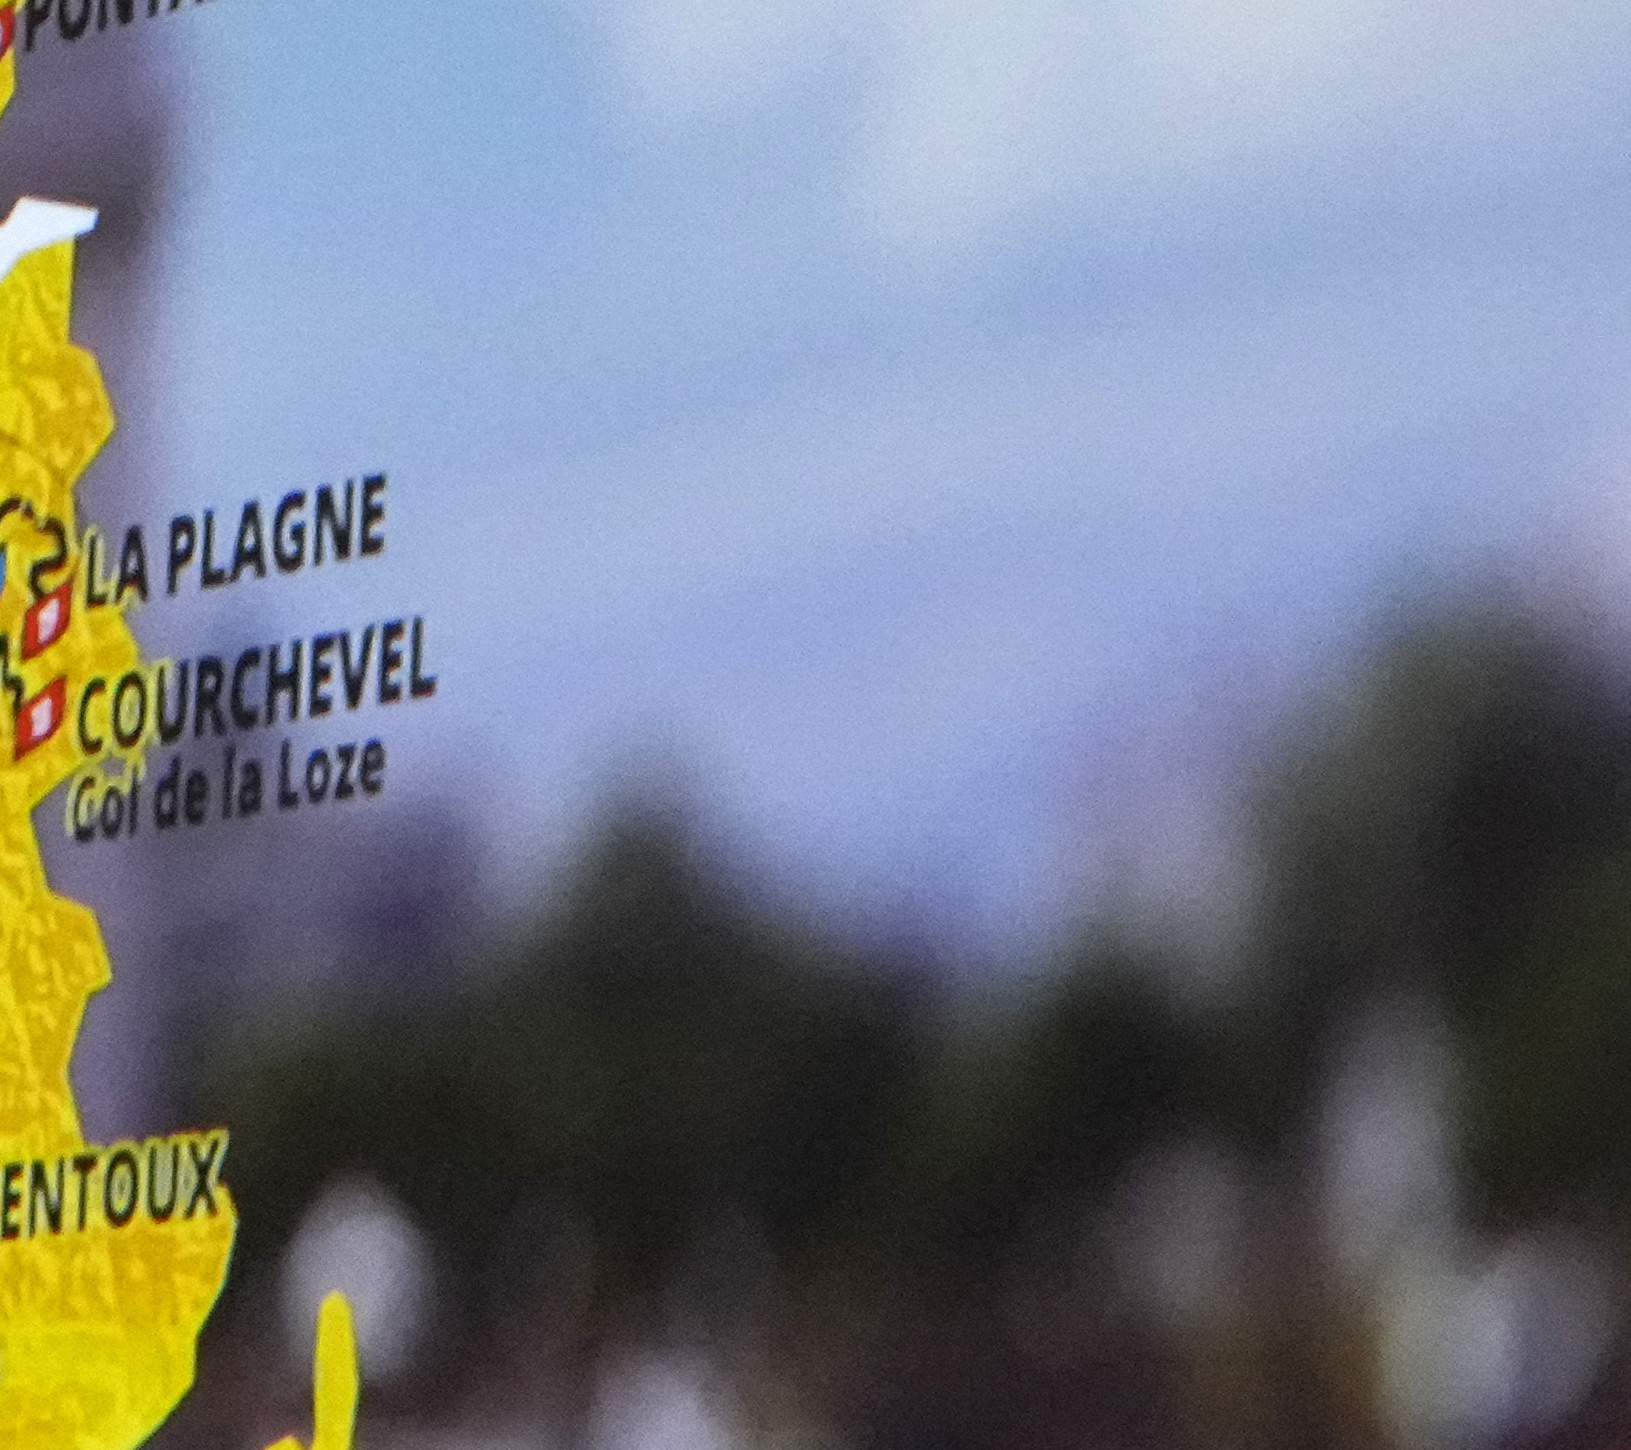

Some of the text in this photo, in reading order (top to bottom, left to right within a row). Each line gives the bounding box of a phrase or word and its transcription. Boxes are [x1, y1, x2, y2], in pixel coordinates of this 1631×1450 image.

[83, 524, 150, 610] LA
[167, 473, 390, 598] PLAGNE
[76, 616, 438, 756] COURCHEVEL
[71, 737, 388, 844] Col de la Loze
